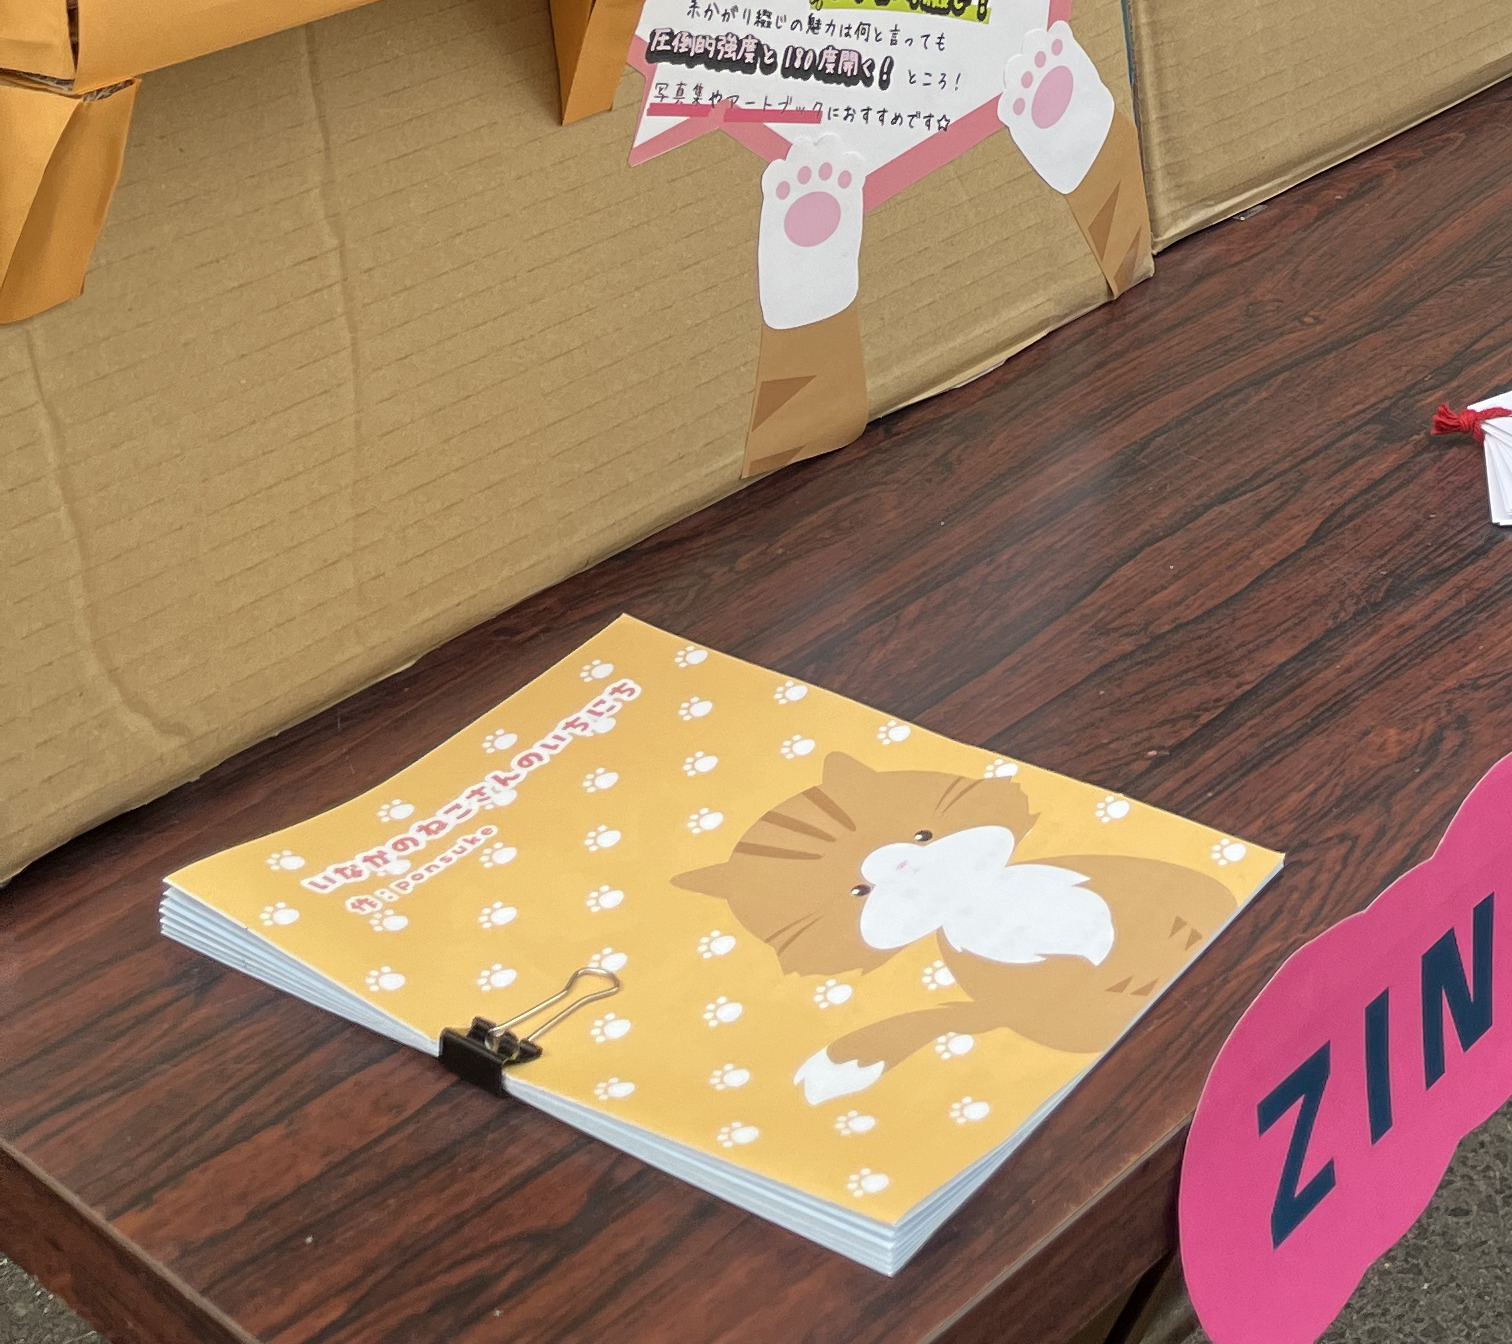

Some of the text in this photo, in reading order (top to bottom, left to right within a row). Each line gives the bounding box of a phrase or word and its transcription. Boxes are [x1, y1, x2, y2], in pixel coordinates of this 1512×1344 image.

[644, 26, 962, 92] 圧倒的強度と180度開く! ところ!
[301, 679, 641, 894] いなかのねこさんのいちにち
